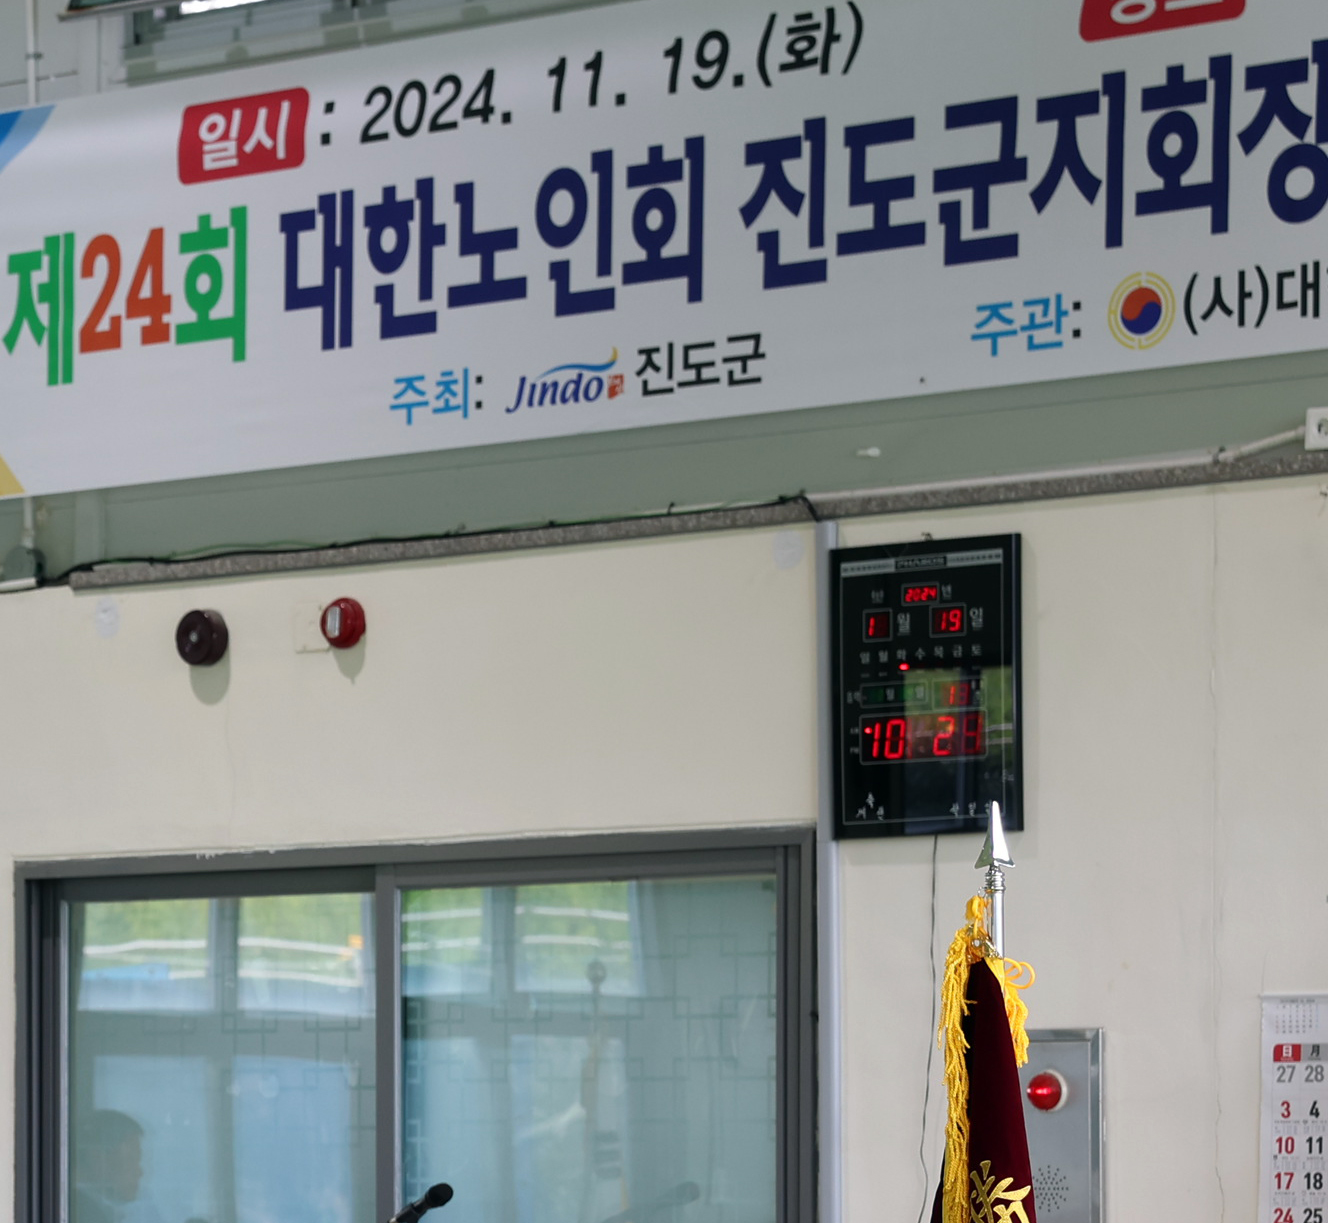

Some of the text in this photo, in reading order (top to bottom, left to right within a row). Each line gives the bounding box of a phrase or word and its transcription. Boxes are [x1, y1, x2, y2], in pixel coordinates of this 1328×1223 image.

[197, 98, 290, 172] 일시
[360, 68, 513, 143] 2024.
[547, 50, 628, 113] 11.
[2, 204, 248, 387] 제24회
[279, 136, 705, 350] 대한노인회
[971, 259, 1328, 357] 주관: (사)대
[505, 362, 606, 413] Jindo
[635, 332, 766, 397] 진도군
[905, 587, 938, 602] 2024
[941, 609, 961, 631] 19
[1277, 1065, 1324, 1082] 27 28
[1281, 1101, 1320, 1118] 3 4
[1276, 1136, 1323, 1154] 10 11
[1274, 1172, 1323, 1190] 17 18
